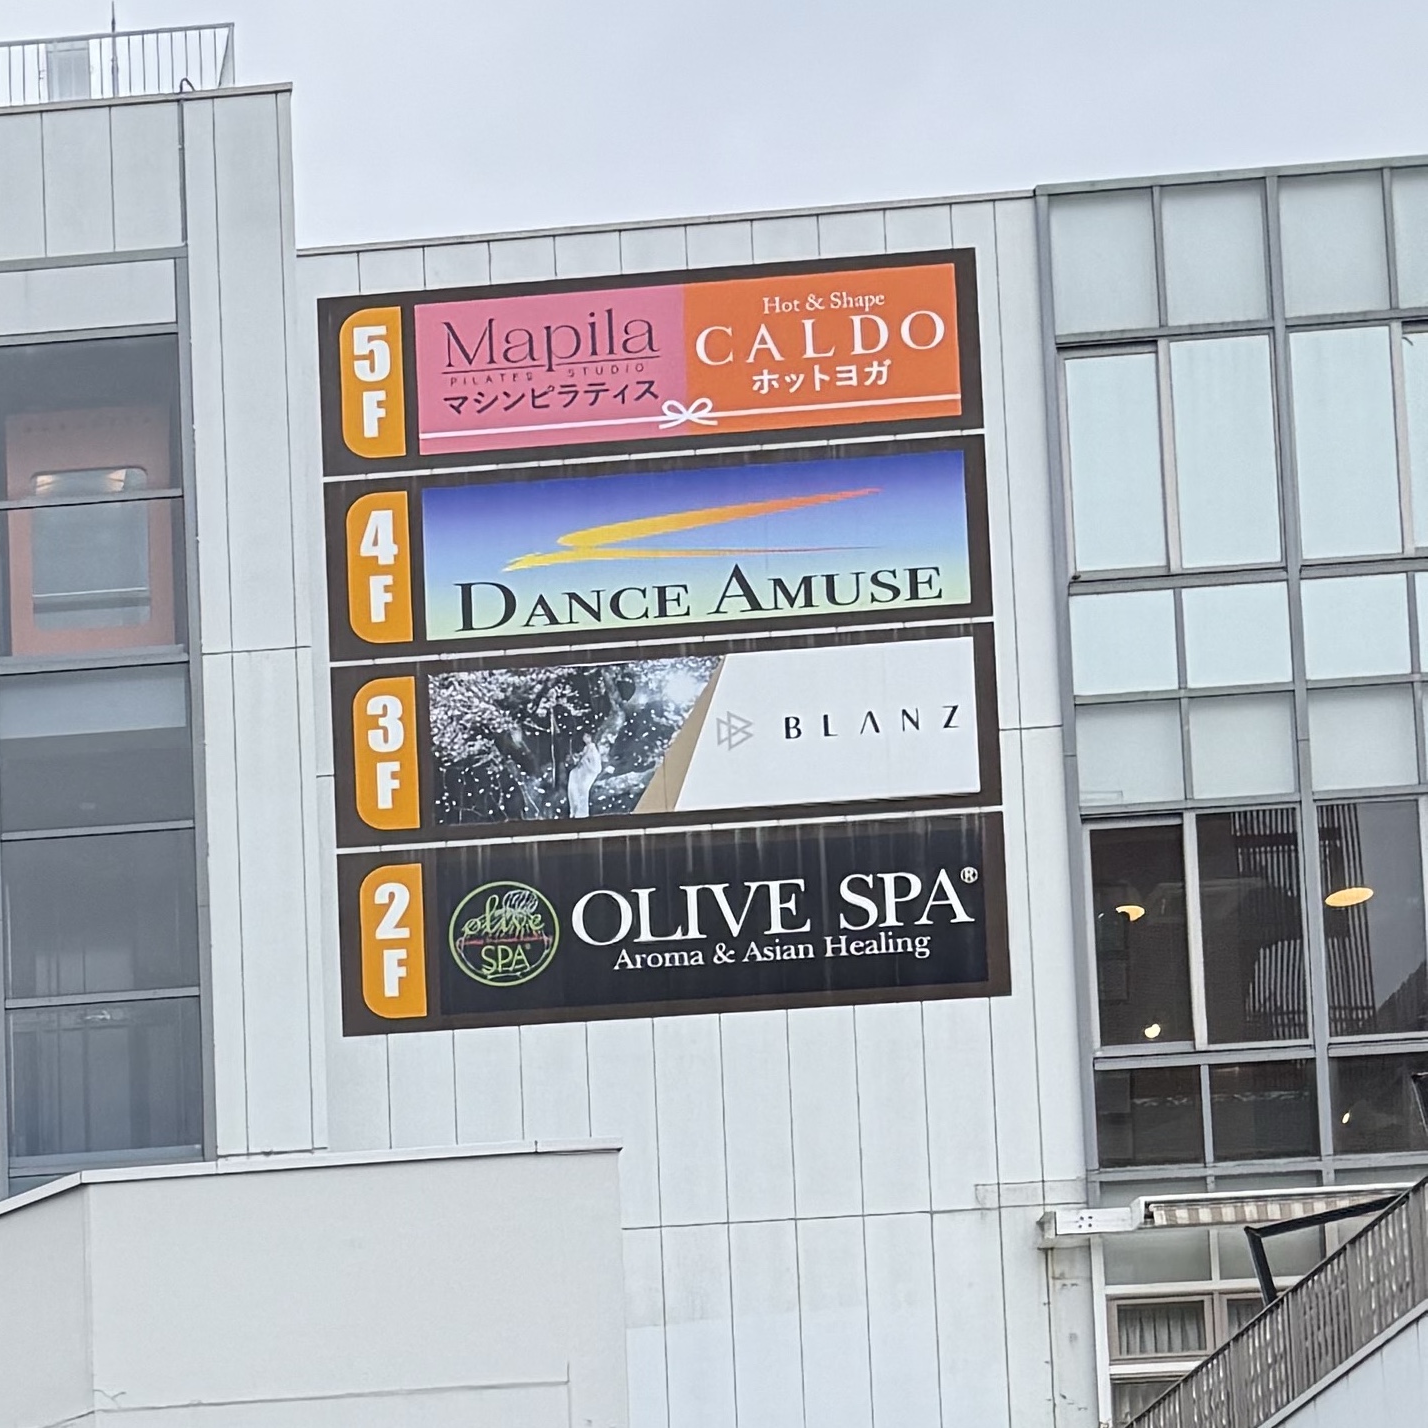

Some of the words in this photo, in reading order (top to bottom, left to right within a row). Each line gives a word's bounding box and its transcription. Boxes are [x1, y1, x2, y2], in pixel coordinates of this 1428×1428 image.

[763, 296, 800, 314] Hot
[805, 293, 825, 311] &
[830, 291, 885, 312] Shape
[442, 308, 661, 372] Mapila
[695, 310, 945, 366] CALDO
[450, 372, 533, 387] PILATES
[568, 362, 645, 378] STUDIO
[752, 358, 892, 395] ホットヨガ
[443, 380, 659, 414] マシンピラティス
[453, 580, 690, 633] DANCE
[707, 562, 944, 616] AMUSE
[571, 878, 812, 947] OLIVE
[613, 948, 705, 970] Aroma
[712, 942, 737, 963] &
[742, 938, 815, 963] Asian
[824, 931, 932, 960] Healing
